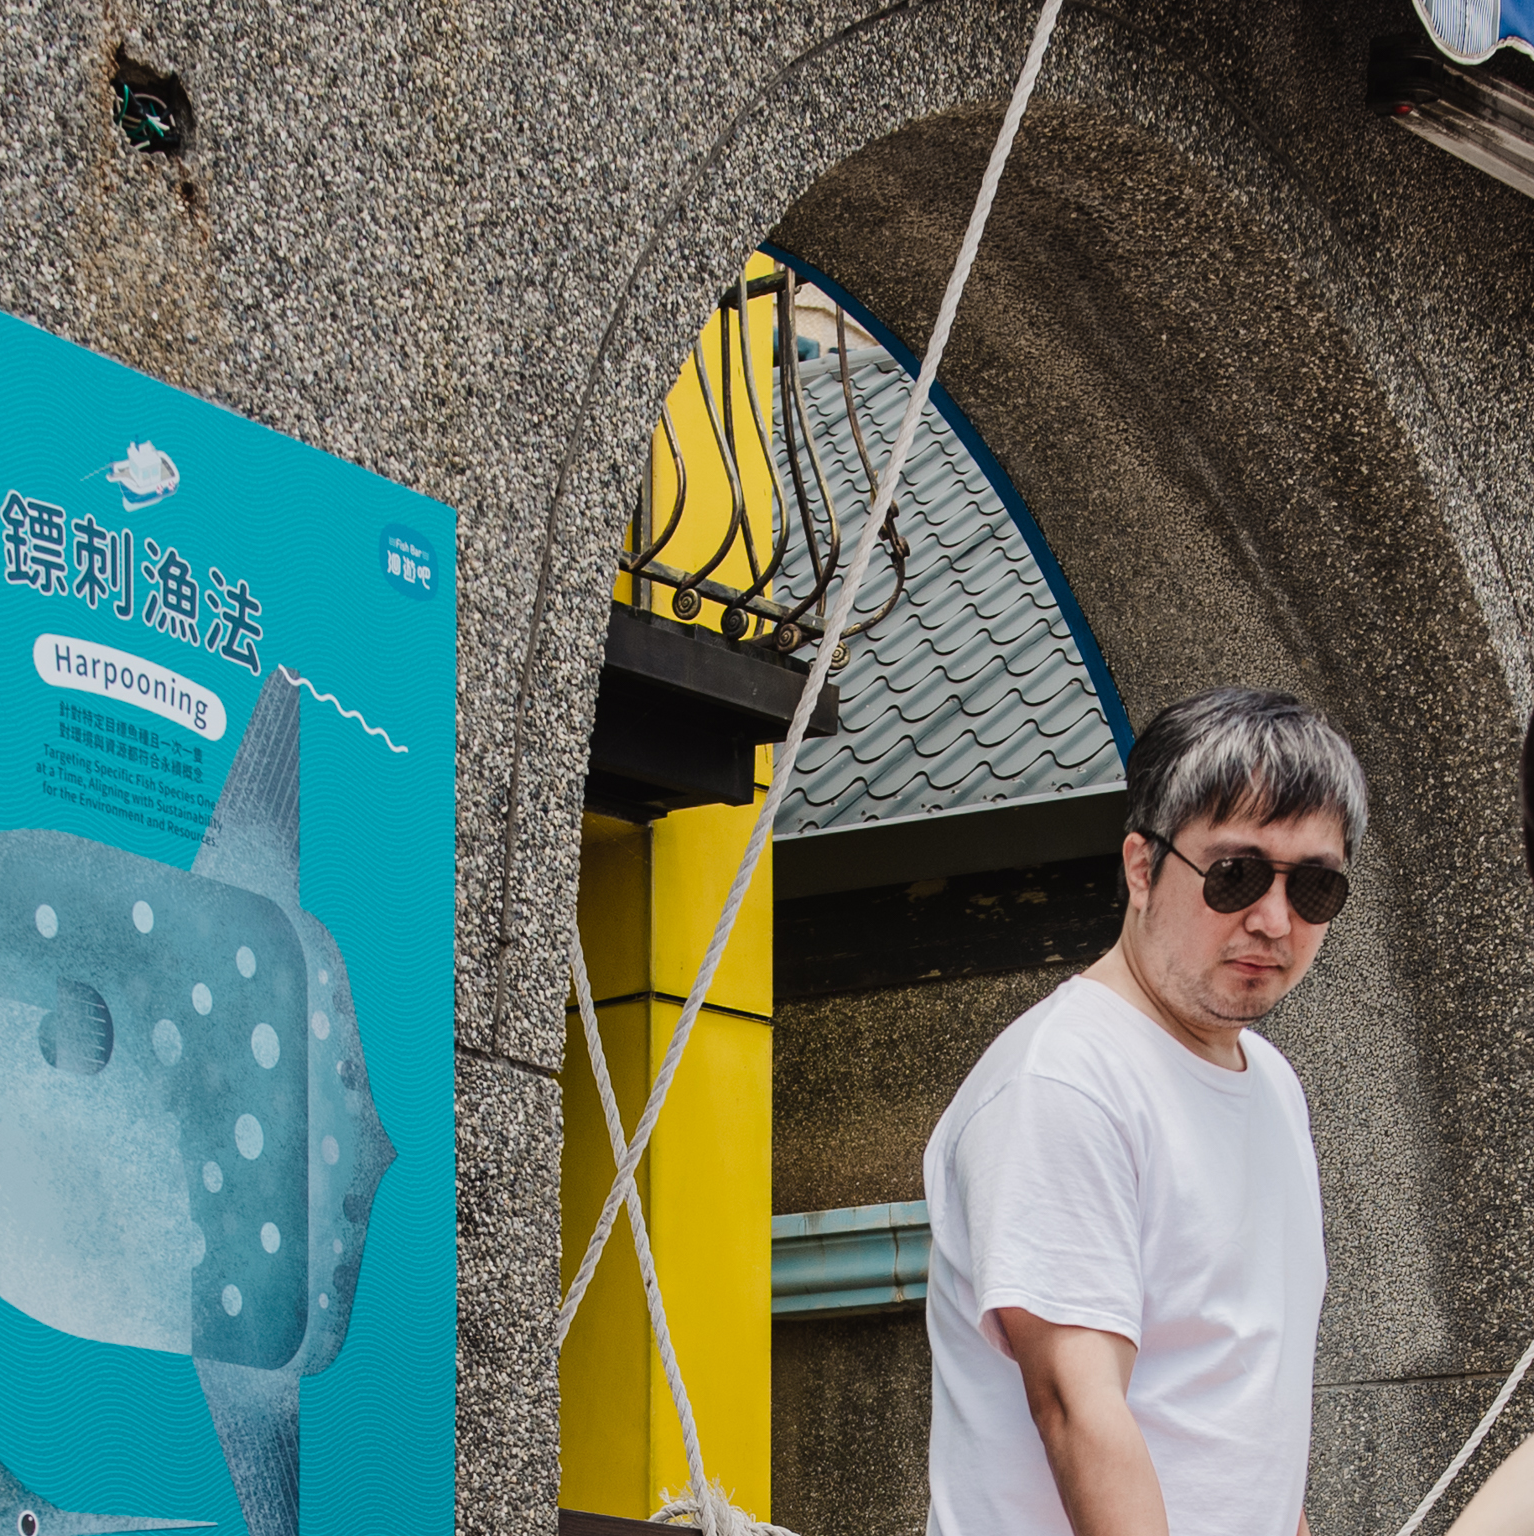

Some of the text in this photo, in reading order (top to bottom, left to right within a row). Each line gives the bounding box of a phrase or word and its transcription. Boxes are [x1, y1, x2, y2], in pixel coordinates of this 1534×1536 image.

[0, 489, 262, 676] 鏢刺漁法
[395, 537, 423, 558] Fish Bar
[55, 643, 209, 730] Harpooning
[36, 761, 223, 834] at a Time, Aligning with Sustainability
[43, 742, 92, 774] Targeting
[93, 760, 134, 786] Specific
[135, 773, 157, 791] Fish
[157, 780, 196, 805] Species
[43, 780, 219, 849] for the Environment and Resources.
